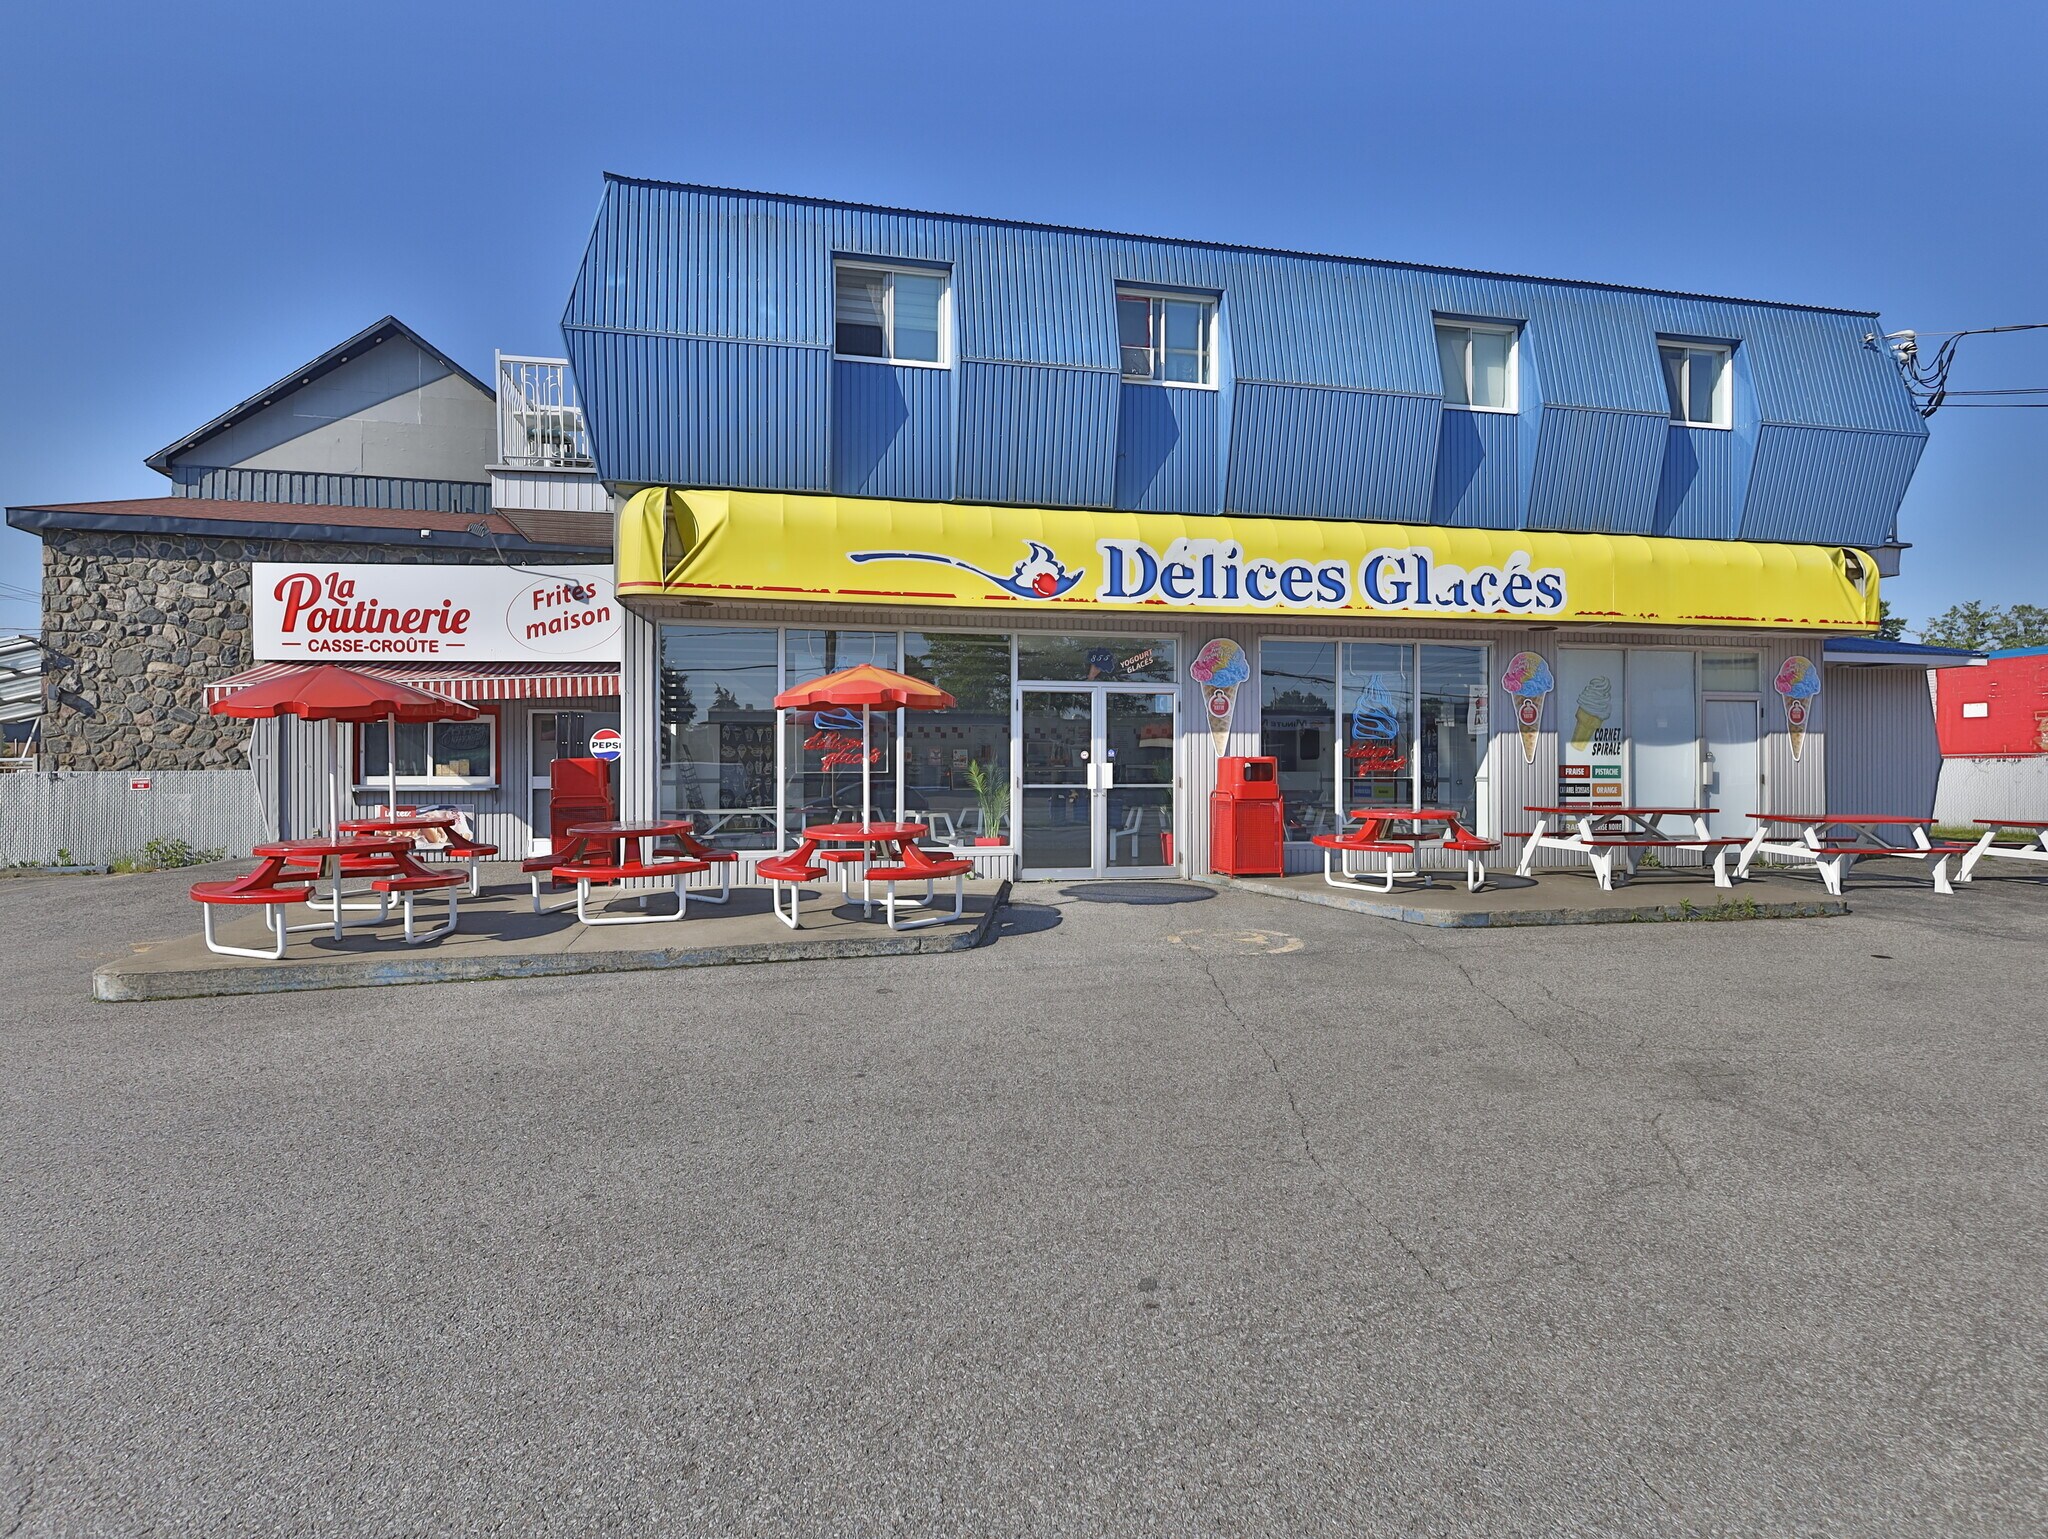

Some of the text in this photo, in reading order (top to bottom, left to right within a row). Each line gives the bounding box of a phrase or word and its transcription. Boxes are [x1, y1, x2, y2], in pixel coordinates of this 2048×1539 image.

[1102, 543, 1346, 604] Délices
[324, 571, 355, 607] La
[532, 582, 597, 611] Frites
[273, 572, 471, 635] Poutinerie
[526, 606, 610, 640] maison
[307, 636, 439, 654] CASSE-CROÛTE
[1119, 648, 1153, 669] YOGOURT
[1594, 727, 1621, 742] CORNET
[1592, 742, 1621, 756] SPIRALE
[1565, 767, 1585, 776] FRAISE
[1594, 768, 1619, 776] PISTACHE
[1596, 786, 1618, 794] ORANGE
